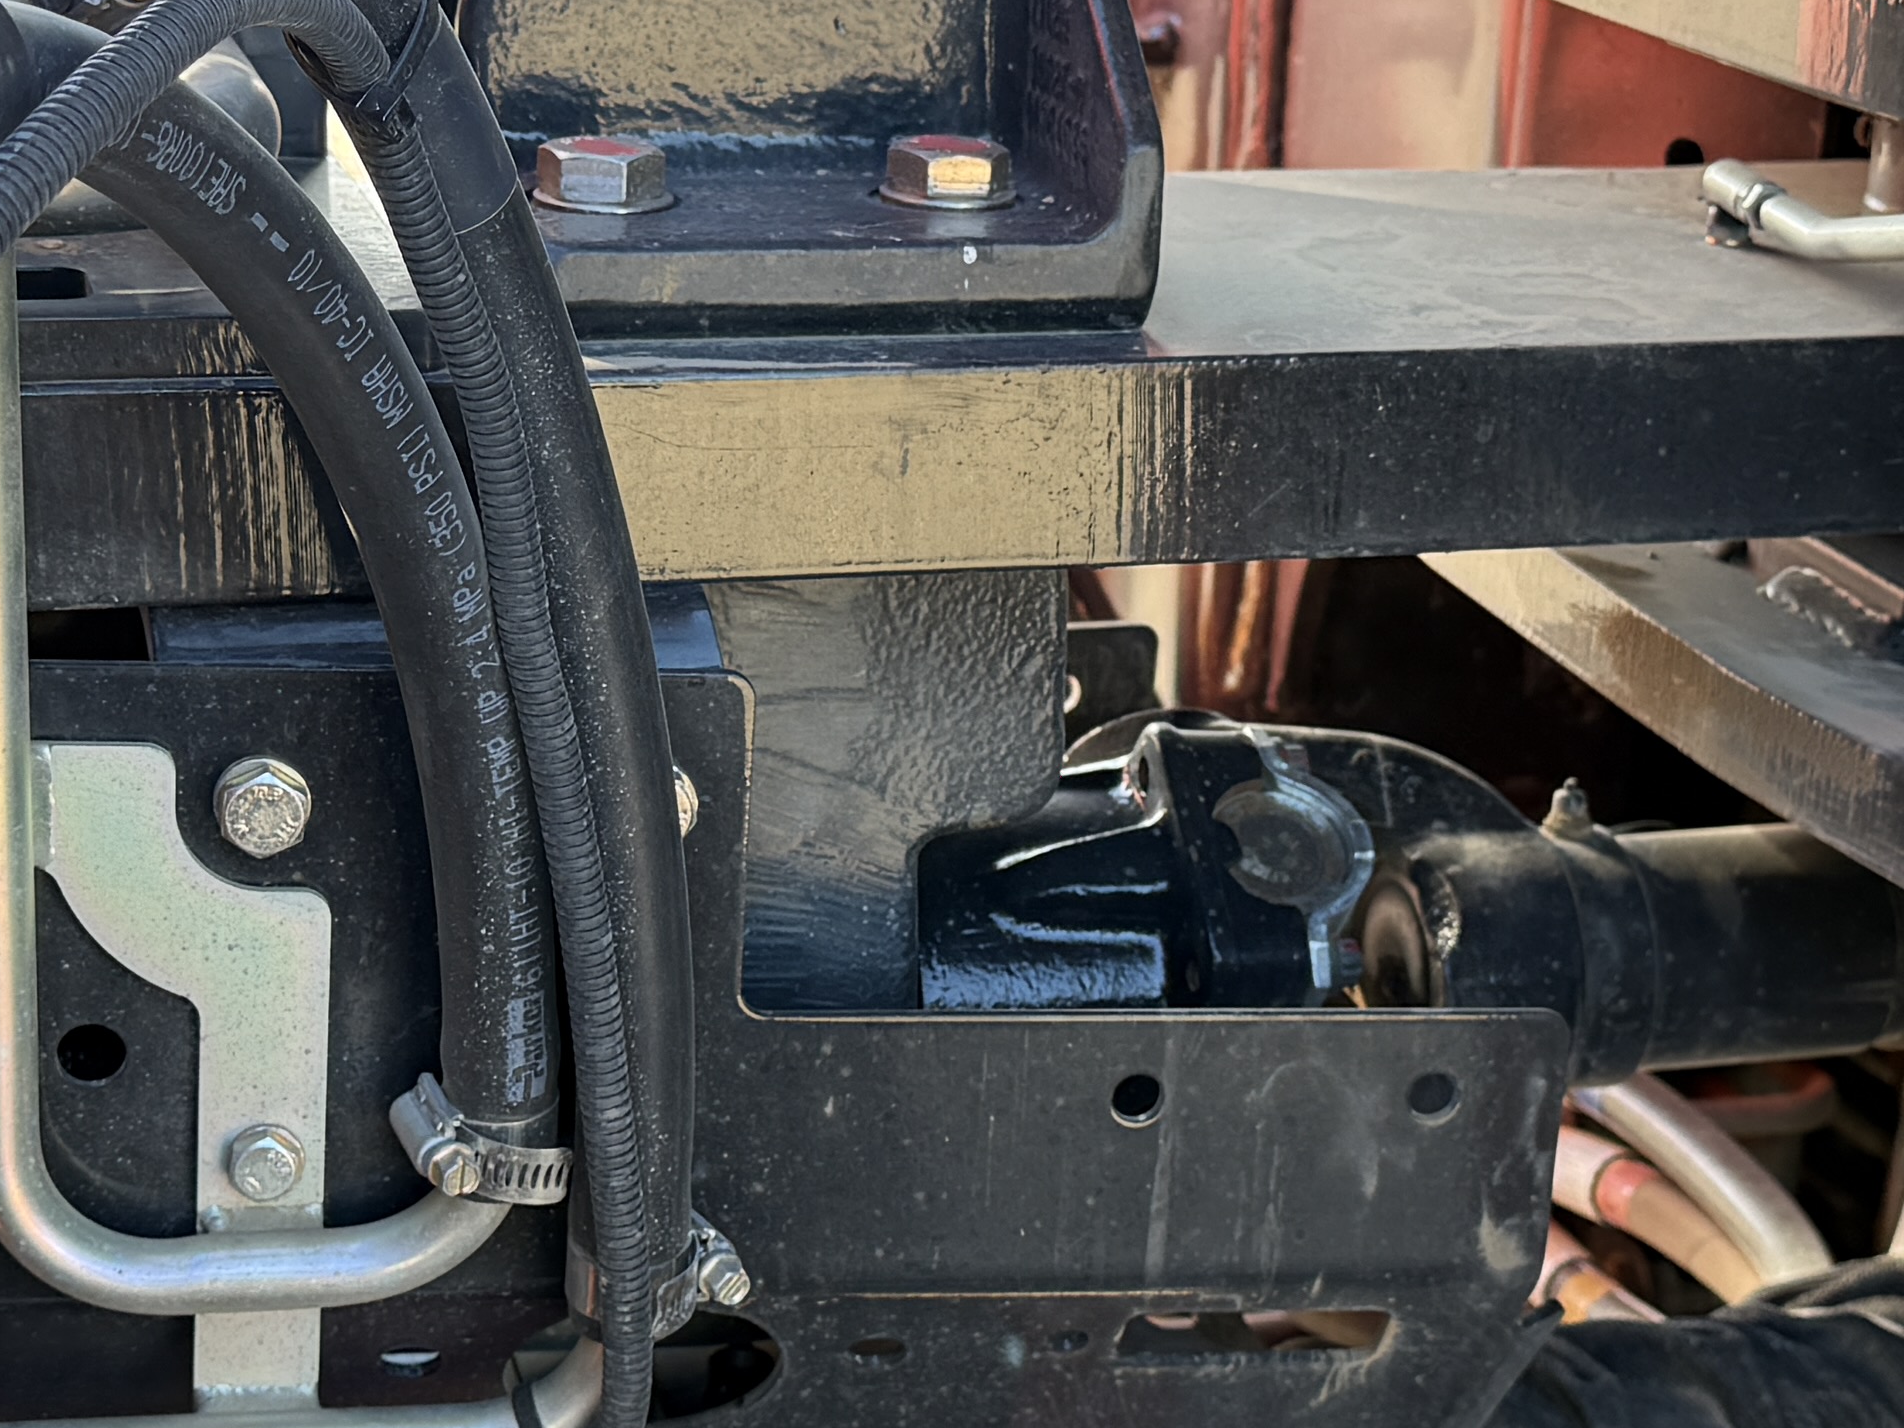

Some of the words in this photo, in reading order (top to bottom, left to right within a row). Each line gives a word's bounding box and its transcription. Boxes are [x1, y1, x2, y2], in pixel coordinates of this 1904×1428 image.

[286, 249, 376, 358] IC-40/10
[359, 352, 413, 432] MSHA
[448, 562, 488, 625] MPa
